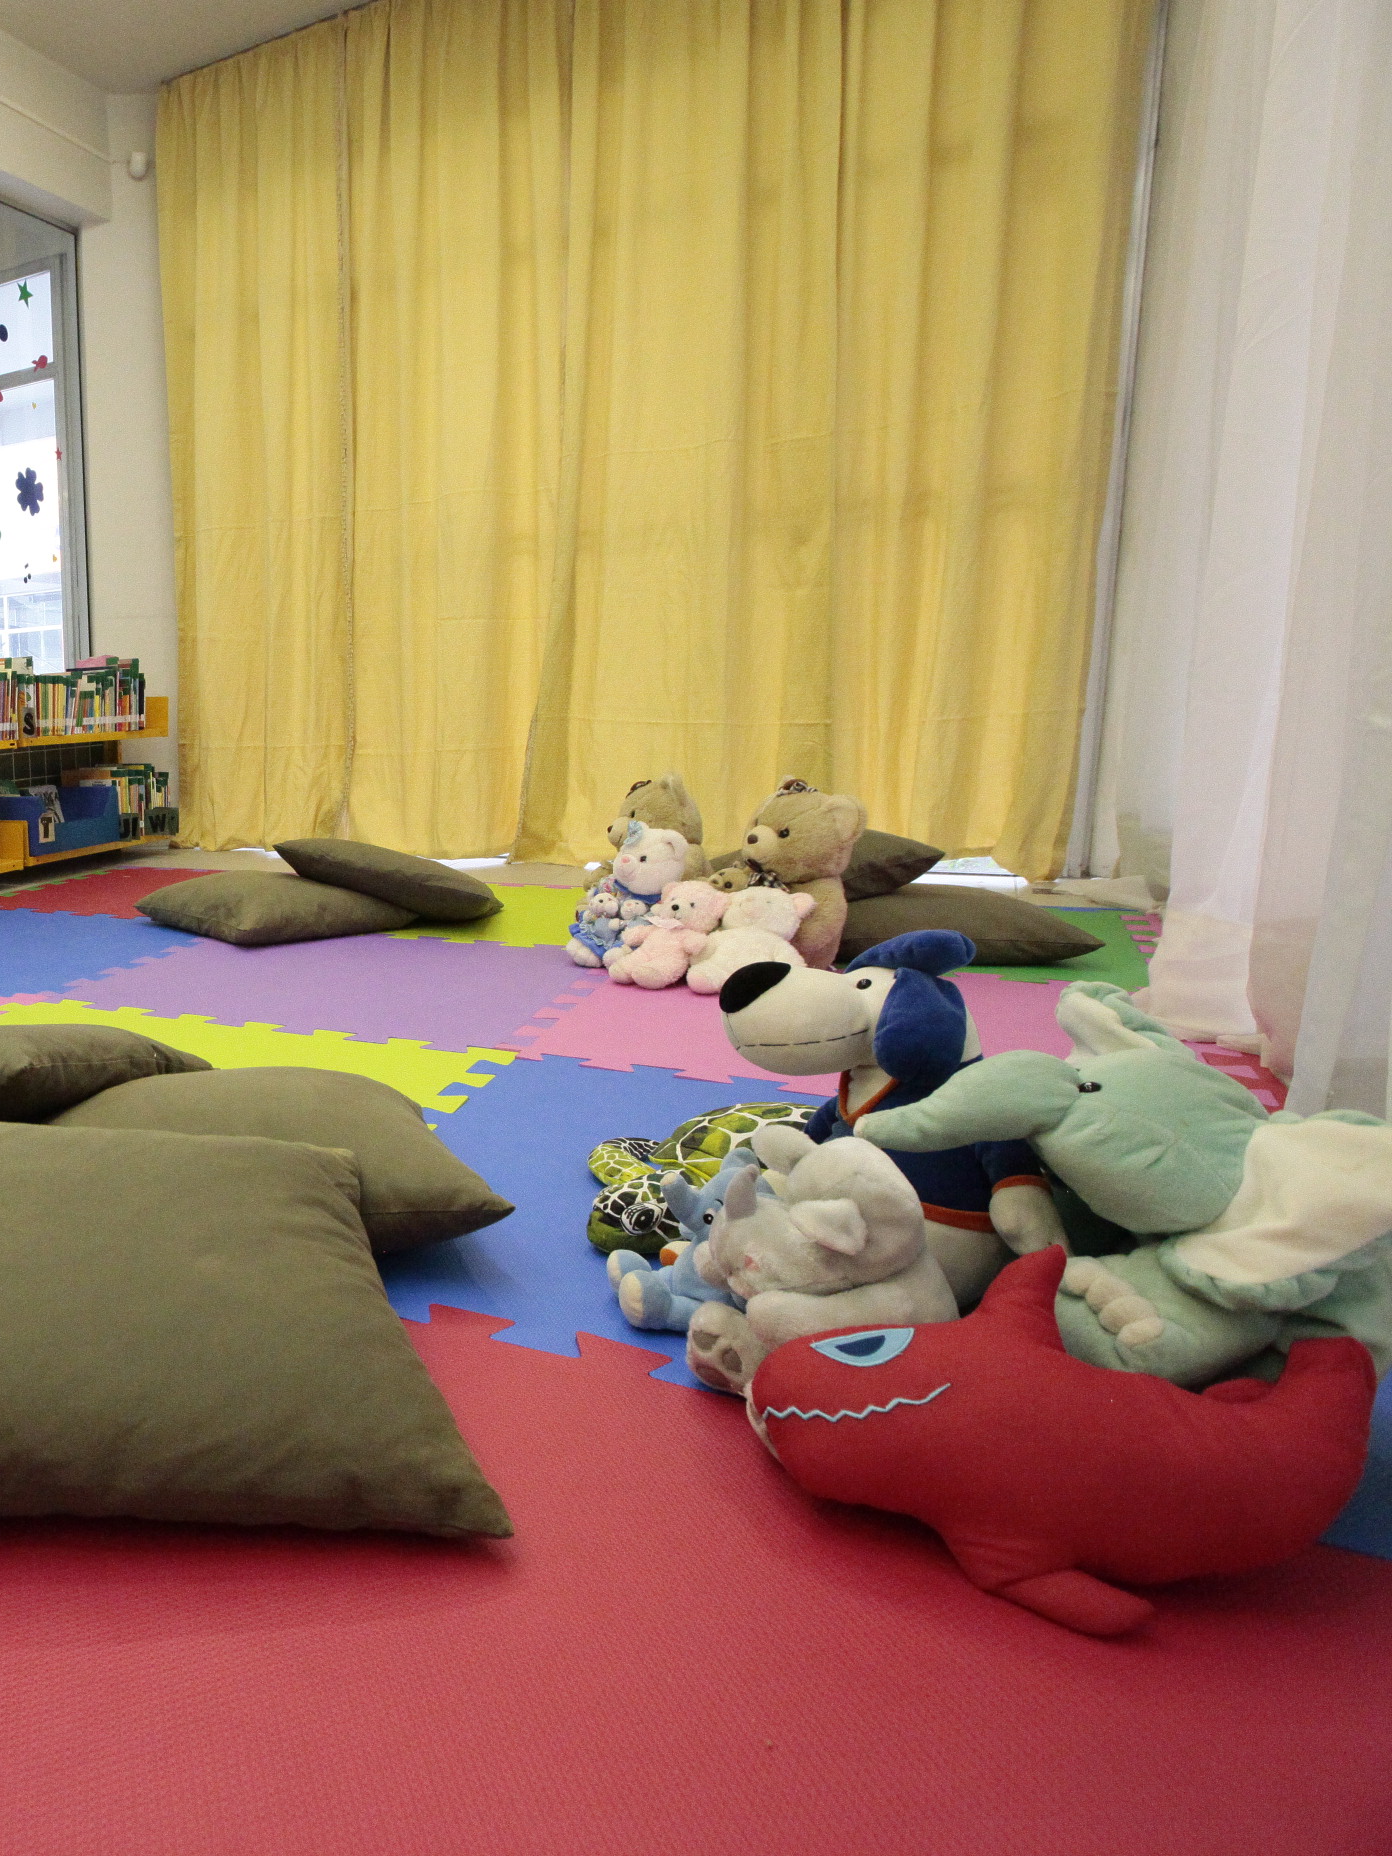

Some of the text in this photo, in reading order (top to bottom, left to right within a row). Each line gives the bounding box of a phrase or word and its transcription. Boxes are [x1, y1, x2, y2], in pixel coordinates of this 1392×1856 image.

[23, 712, 35, 736] S
[41, 816, 53, 839] T
[148, 813, 167, 833] W
